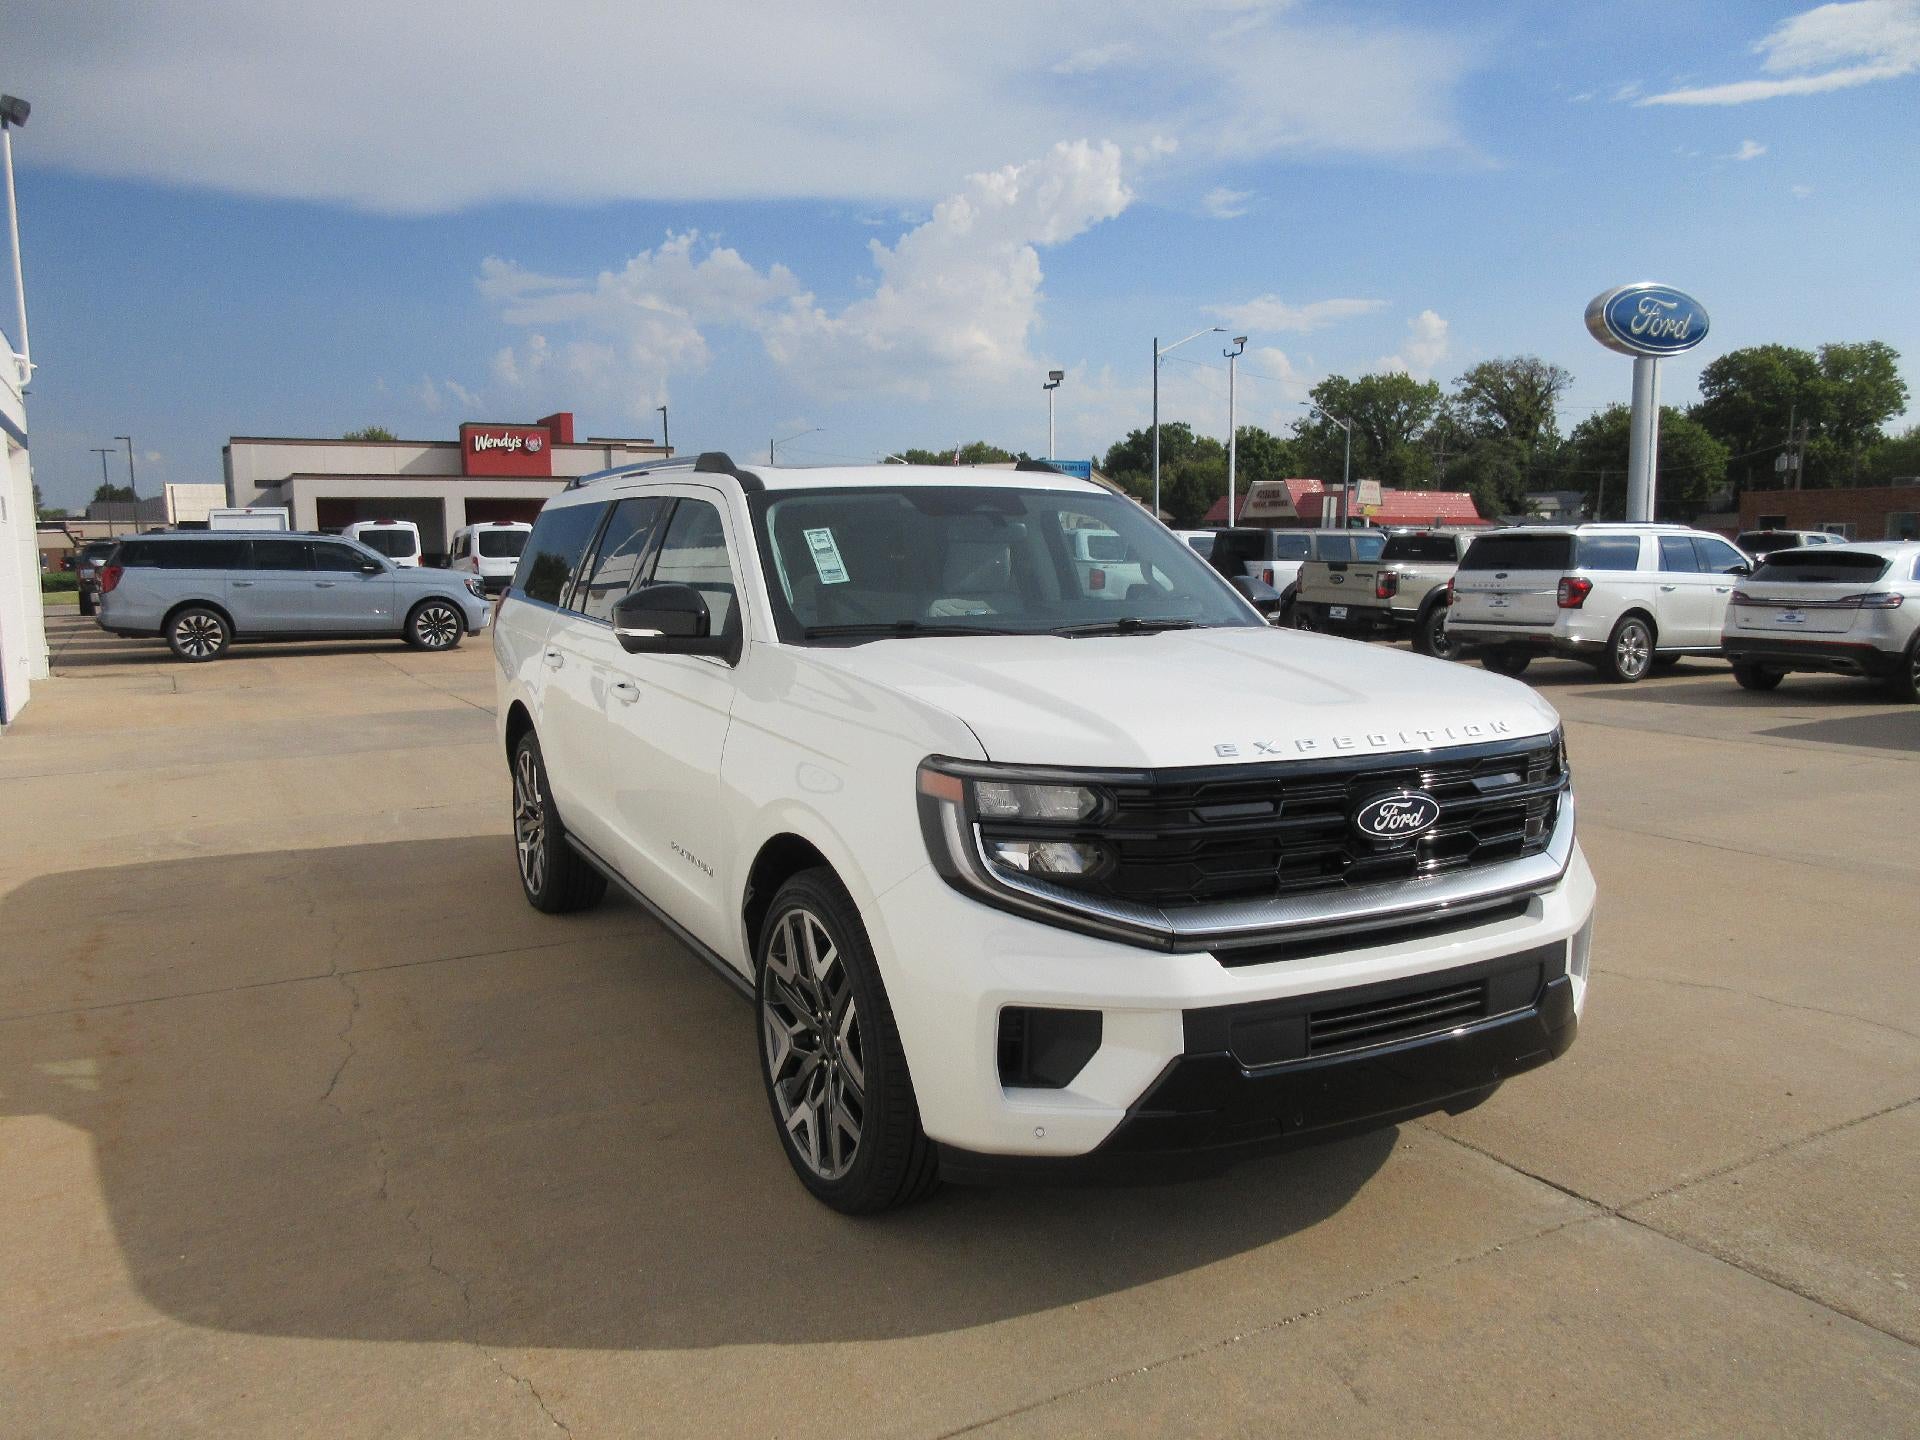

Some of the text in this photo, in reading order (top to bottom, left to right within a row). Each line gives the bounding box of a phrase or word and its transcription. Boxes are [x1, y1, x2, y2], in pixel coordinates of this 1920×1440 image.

[1631, 297, 1692, 339] Ford
[475, 432, 521, 452] Wendy's
[1215, 720, 1512, 757] EXPEDITION
[1374, 801, 1423, 830] Ford
